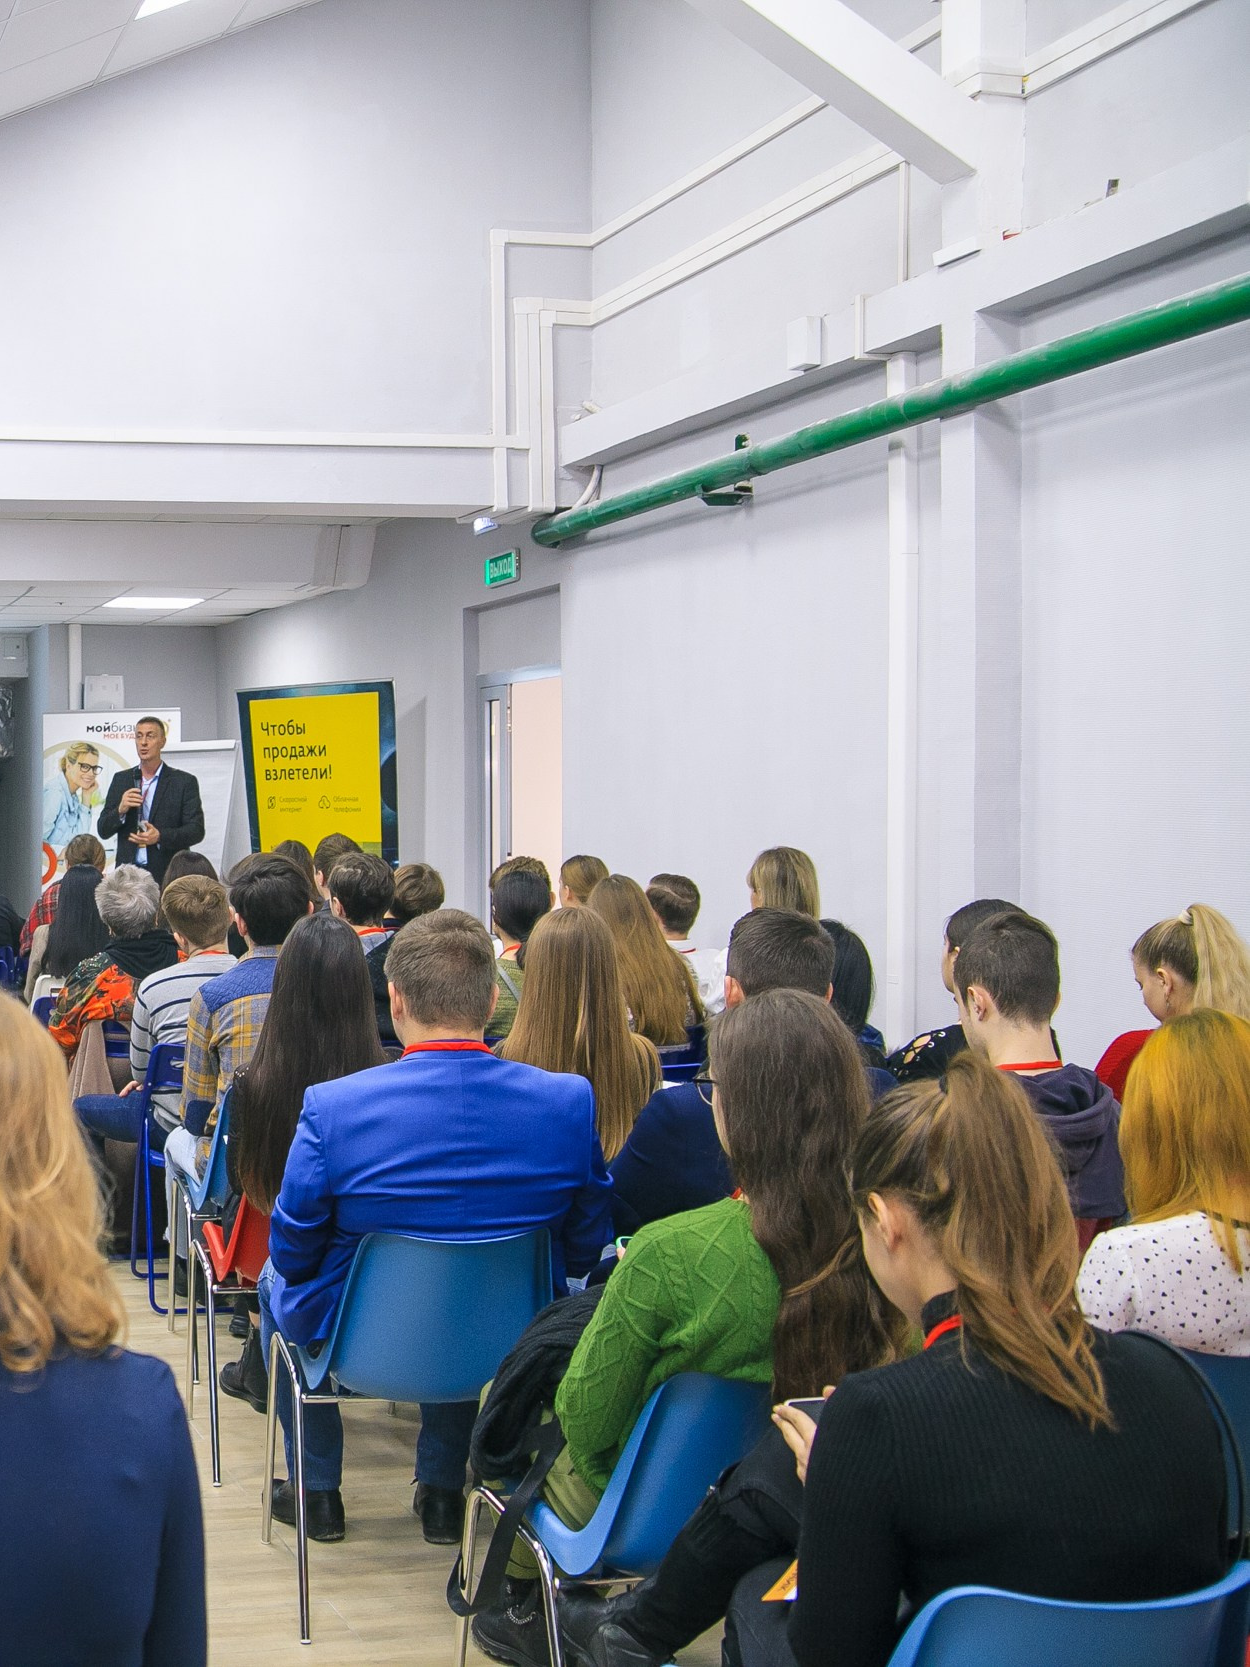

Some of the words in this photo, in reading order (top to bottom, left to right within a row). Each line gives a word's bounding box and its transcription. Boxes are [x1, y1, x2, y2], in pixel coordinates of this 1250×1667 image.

[261, 719, 306, 736] Чтобы
[263, 744, 327, 762] продажи
[265, 764, 332, 781] взлетели!
